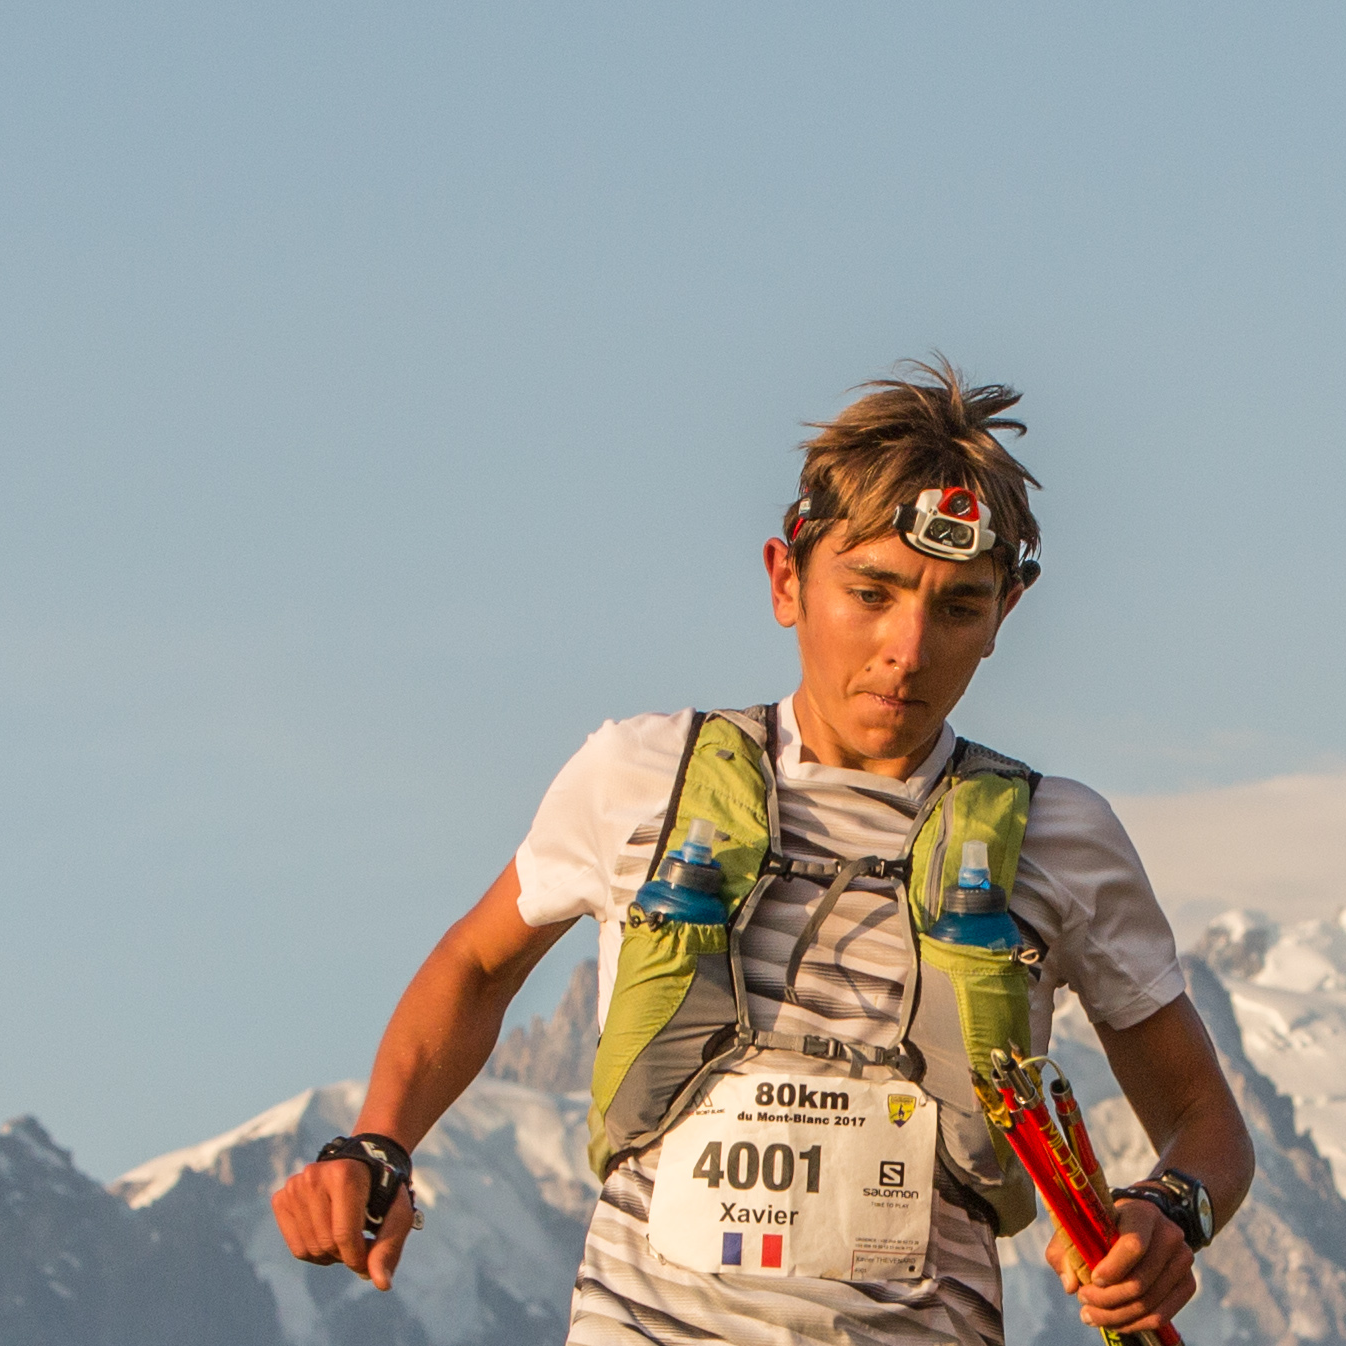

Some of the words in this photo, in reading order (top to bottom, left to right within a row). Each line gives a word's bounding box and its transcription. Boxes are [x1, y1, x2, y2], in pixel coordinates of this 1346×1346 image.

[755, 1082, 849, 1110] 80km
[737, 1111, 753, 1121] du
[757, 1112, 830, 1125] Mont-Blanc
[834, 1116, 866, 1127] 2017
[693, 1141, 822, 1194] 4001
[719, 1202, 799, 1226] Xavier
